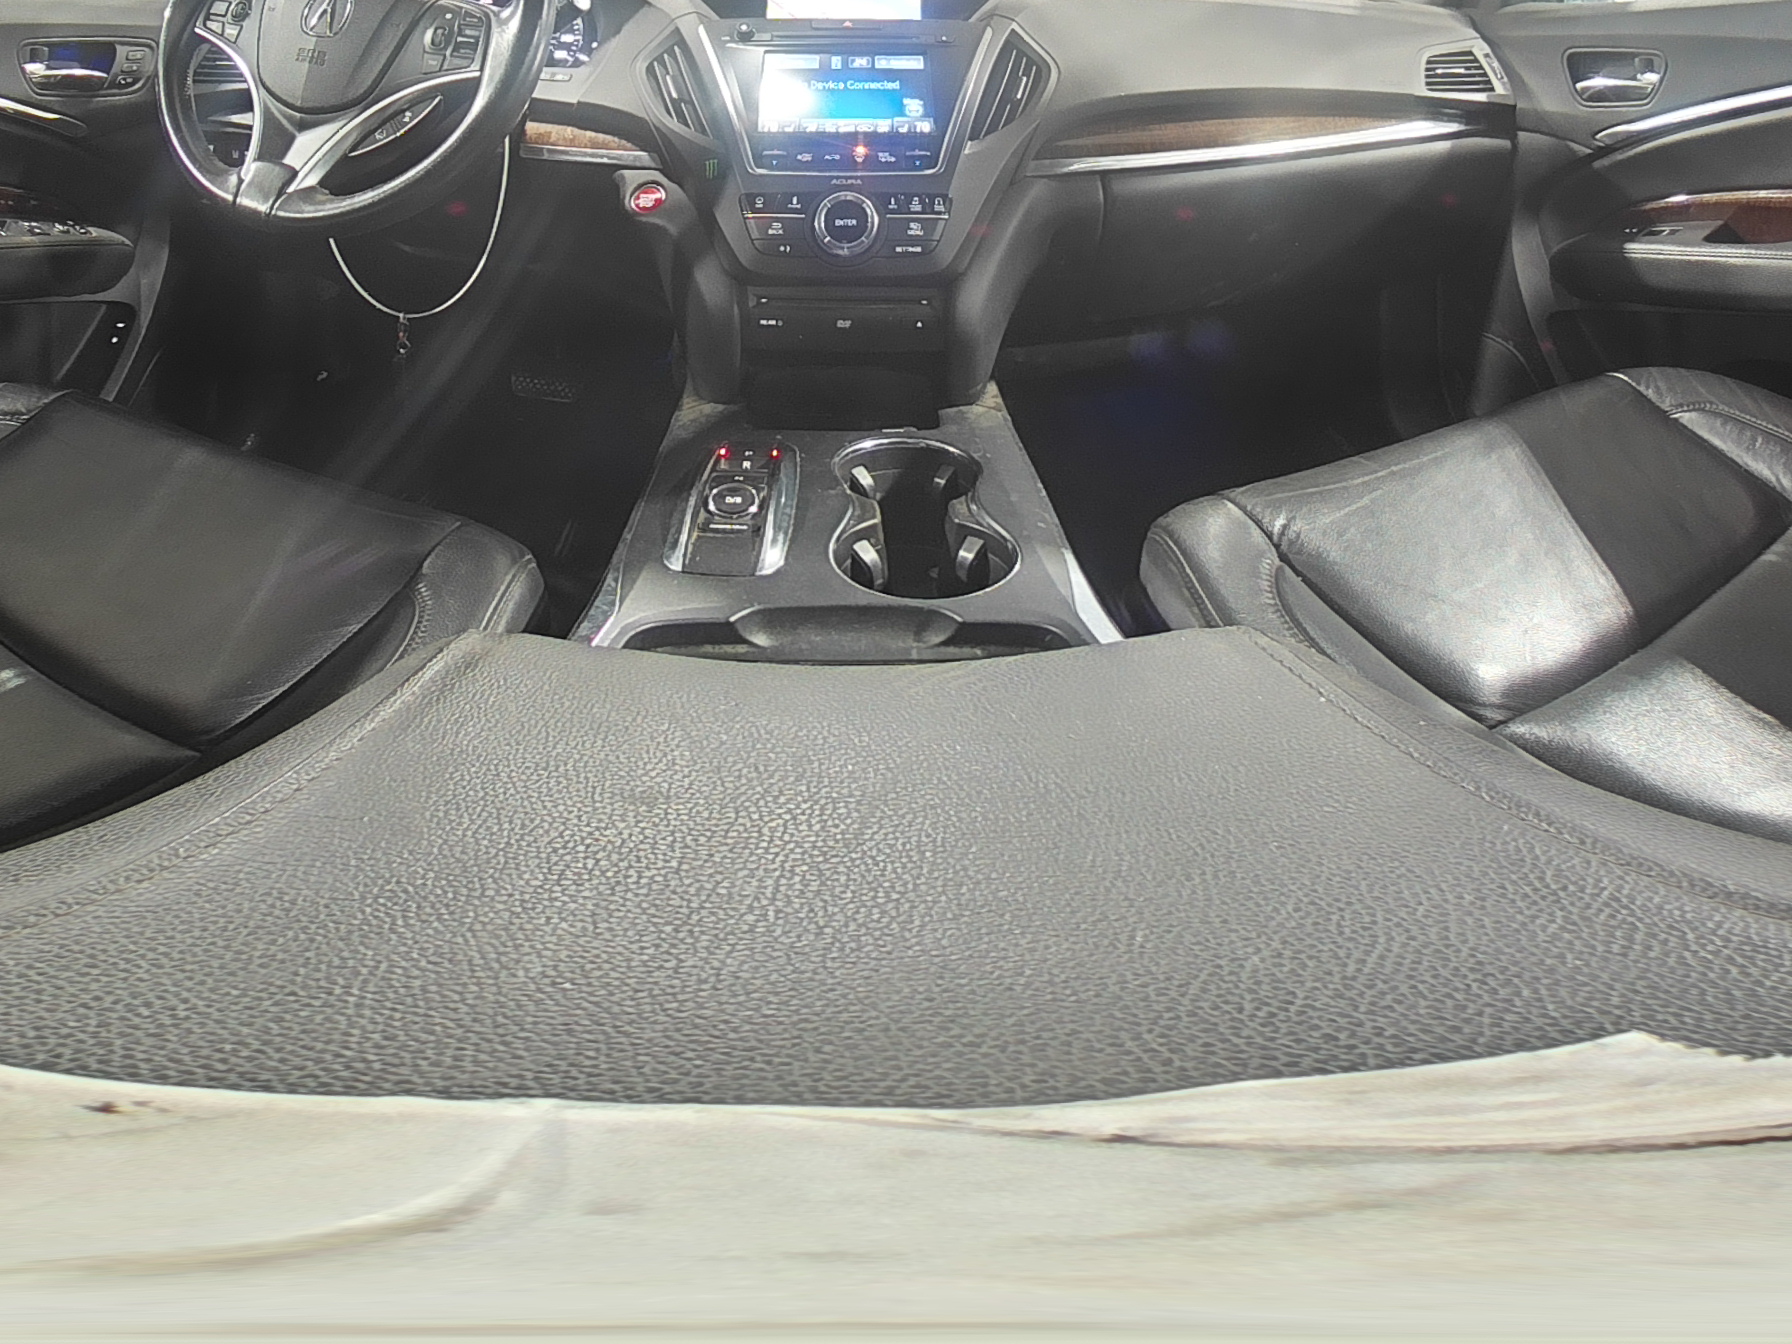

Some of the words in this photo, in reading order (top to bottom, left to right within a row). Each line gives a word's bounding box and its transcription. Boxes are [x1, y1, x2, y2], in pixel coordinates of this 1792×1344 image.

[810, 80, 844, 90] Device
[847, 80, 900, 90] Connected
[914, 121, 931, 132] 70
[834, 219, 857, 227] ENTER
[742, 460, 752, 470] R
